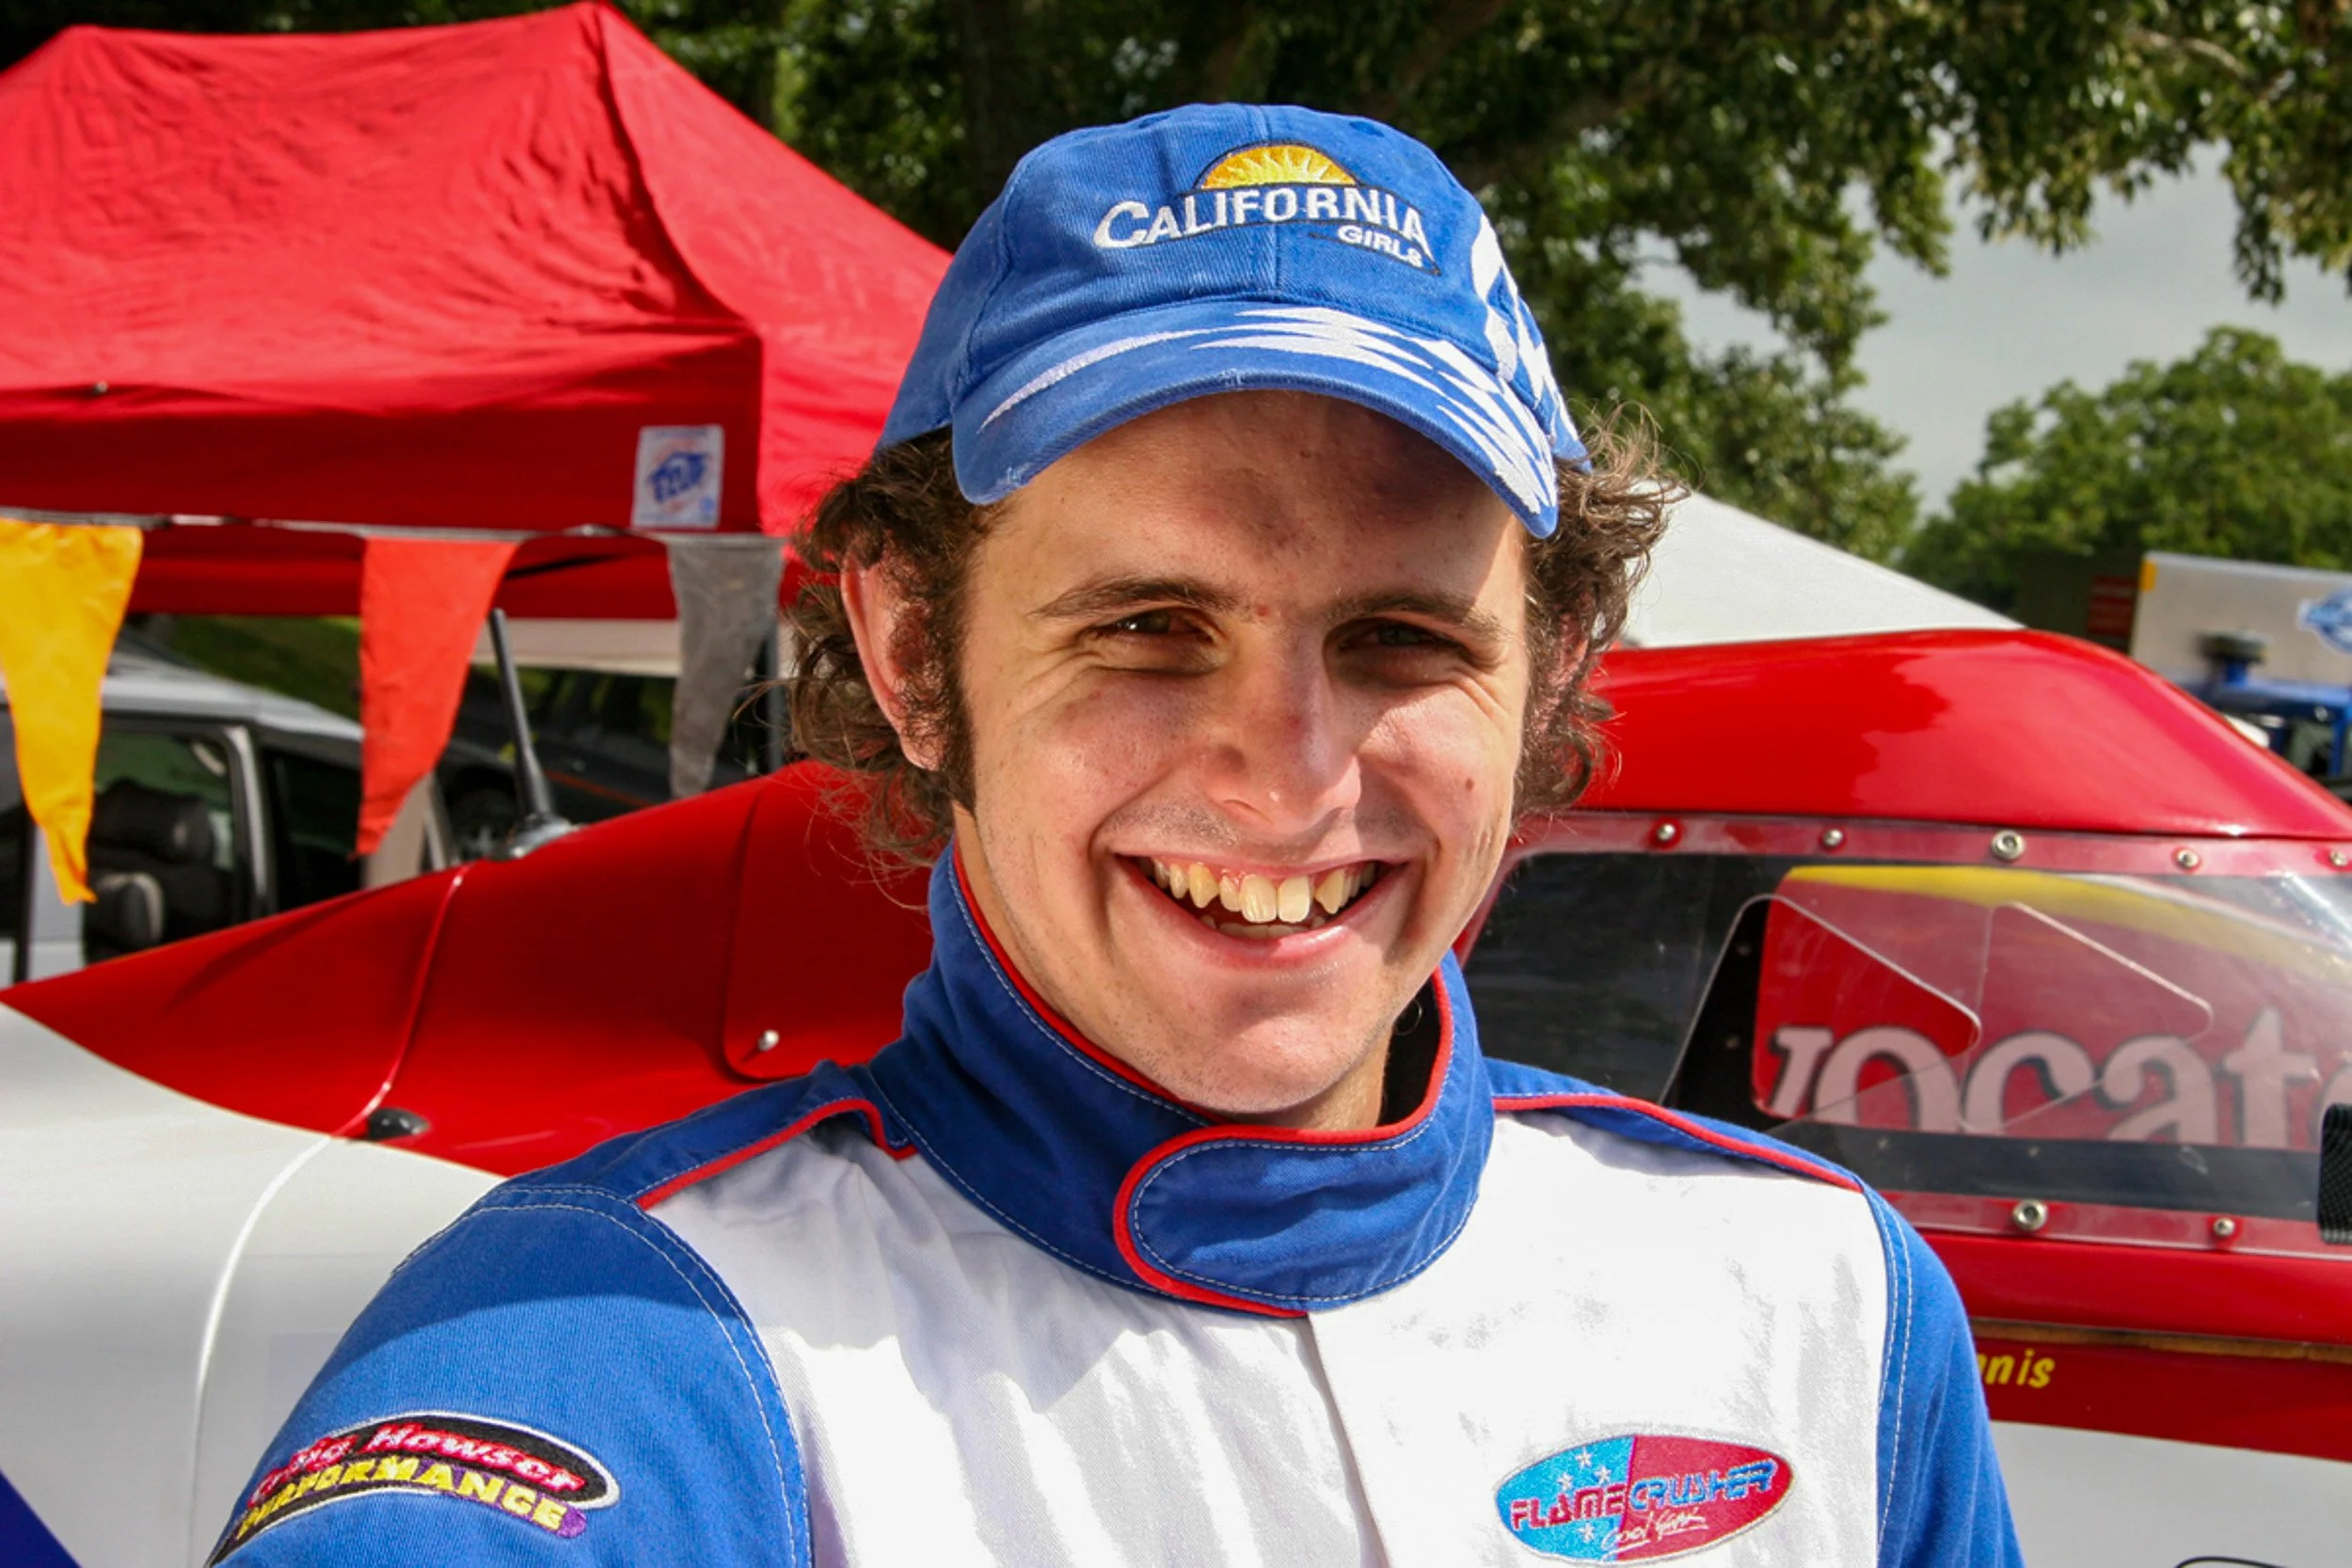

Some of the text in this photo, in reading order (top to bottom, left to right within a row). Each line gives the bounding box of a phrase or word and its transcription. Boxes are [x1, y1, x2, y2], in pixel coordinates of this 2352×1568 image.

[1093, 187, 1435, 262] CALIFORNIA
[1338, 224, 1424, 268] GIRLS
[1774, 1006, 2352, 1148] ocat
[1511, 1459, 1777, 1530] FLAME CRUSHER
